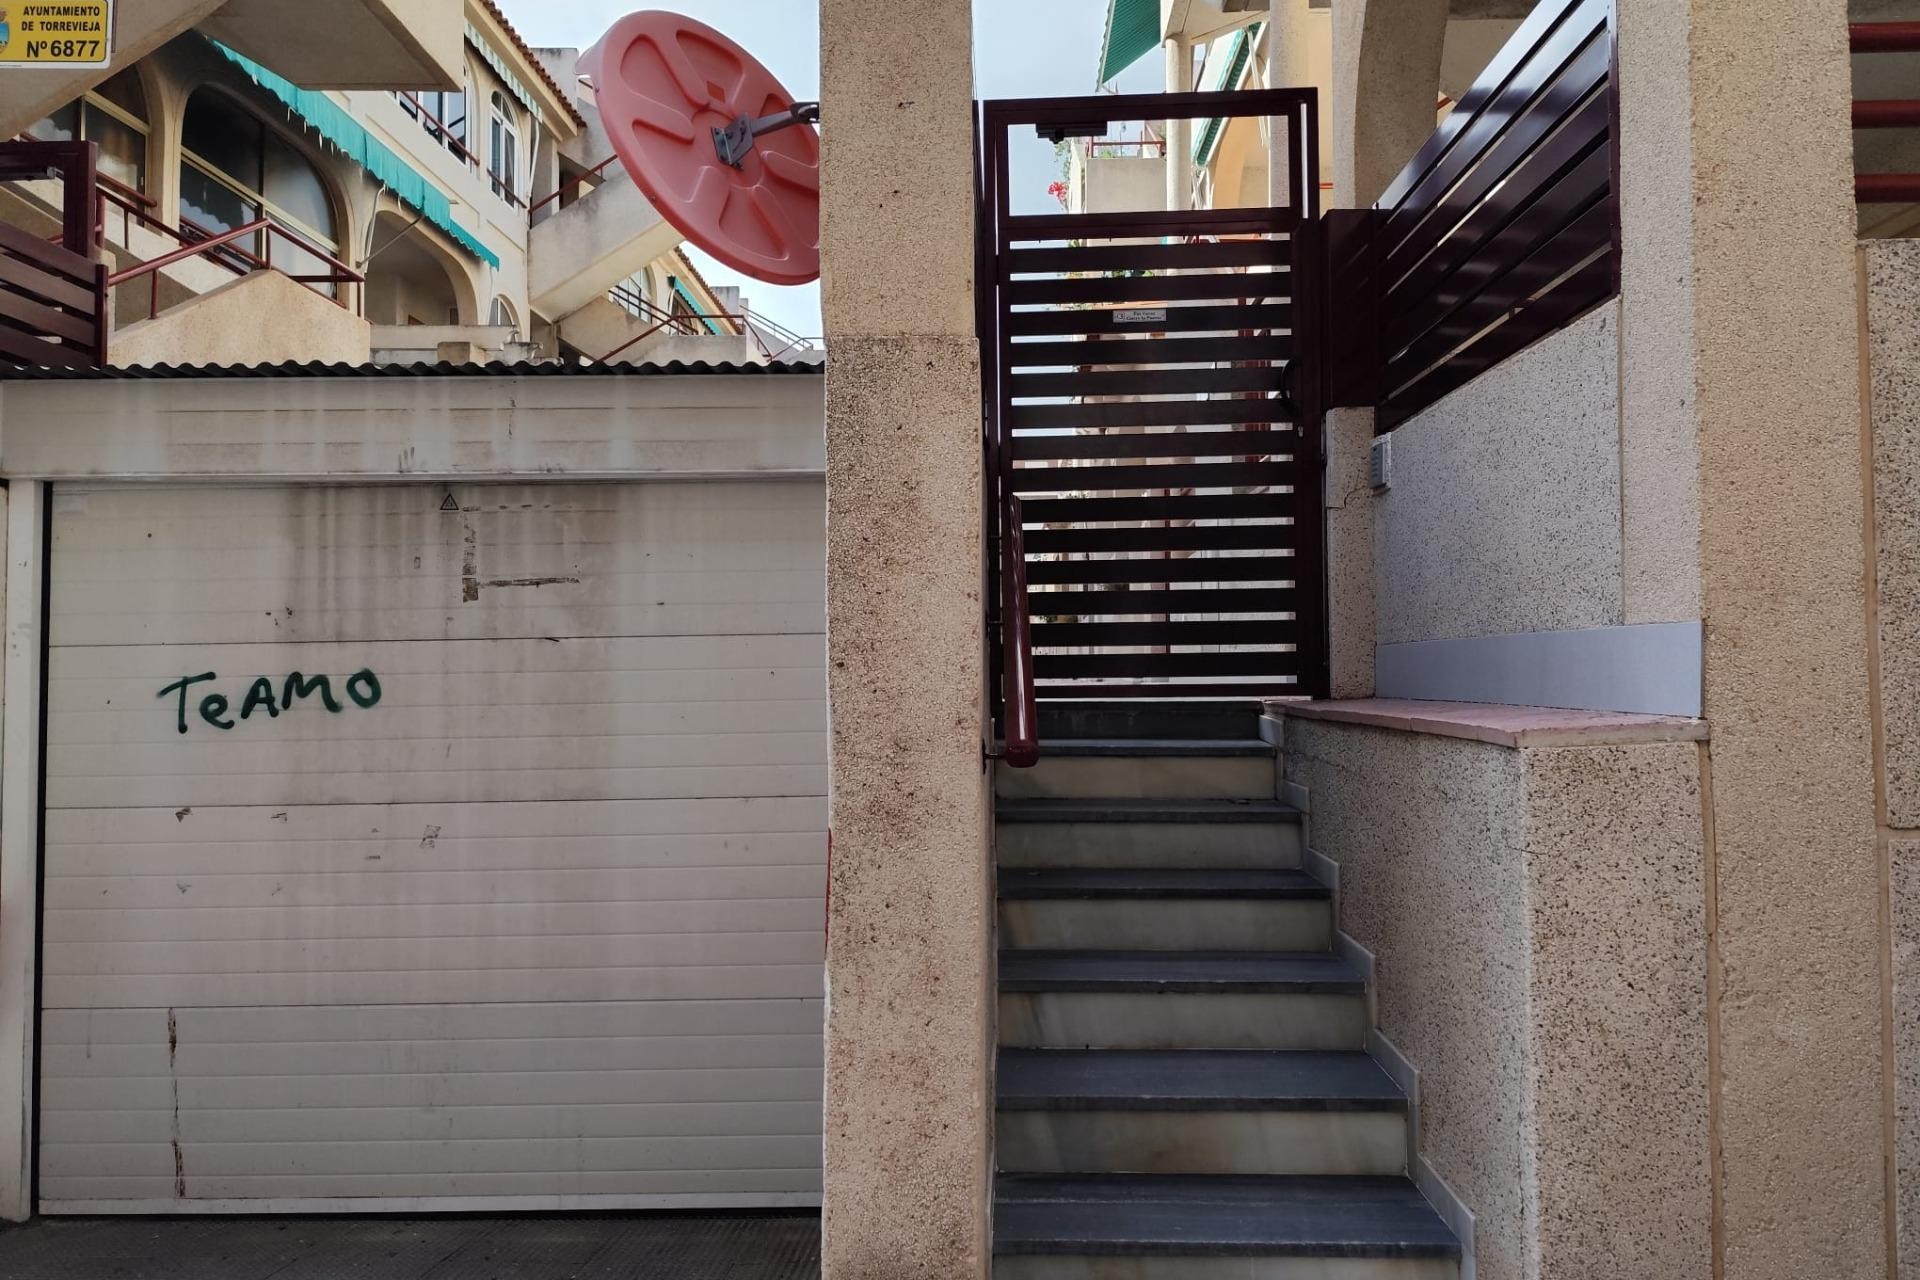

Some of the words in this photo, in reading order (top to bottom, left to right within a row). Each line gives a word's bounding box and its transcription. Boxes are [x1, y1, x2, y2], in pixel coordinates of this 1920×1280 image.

[23, 6, 100, 16] AYUNTAMIENTO
[21, 21, 34, 31] DE
[40, 21, 101, 31] TORREVIEJA
